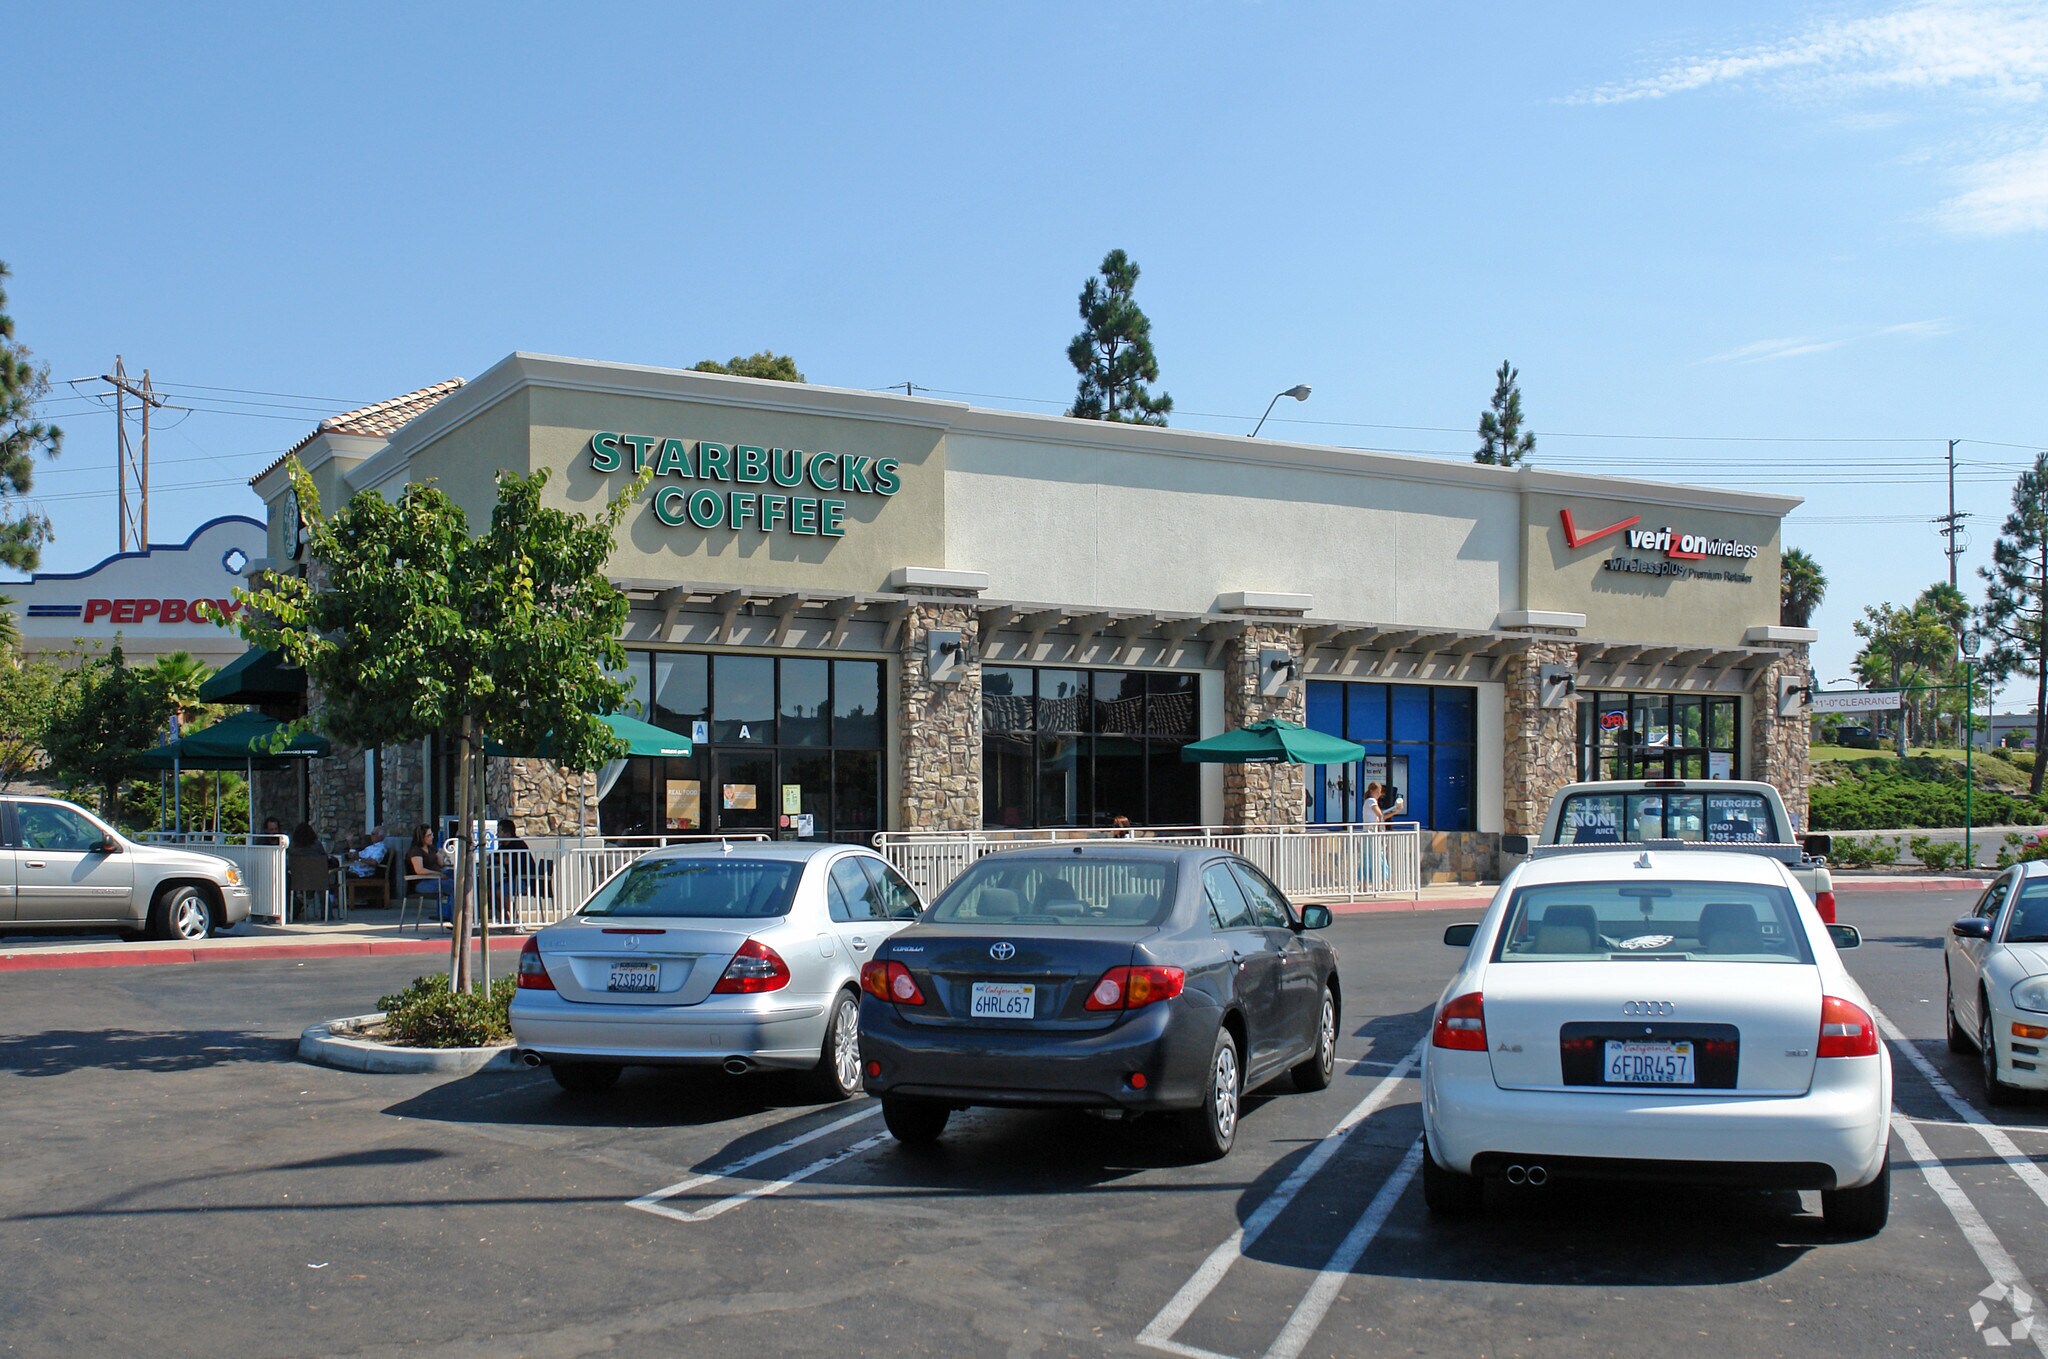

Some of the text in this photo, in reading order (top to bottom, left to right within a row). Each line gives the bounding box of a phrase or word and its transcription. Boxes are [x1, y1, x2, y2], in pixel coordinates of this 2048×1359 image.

[591, 431, 901, 496] STARBUCKS
[653, 485, 846, 537] COFFEE
[1688, 568, 1722, 581] Premium
[1723, 571, 1753, 583] Retailer
[1840, 696, 1898, 707] CLEARANCE
[1601, 714, 1624, 728] OPEN
[696, 725, 704, 736] A
[739, 725, 751, 739] A
[1710, 800, 1762, 808] ENERGIZES
[1570, 813, 1616, 827] NONI
[1709, 823, 1733, 831] (760)
[975, 996, 1030, 1013] 6HRL657
[1612, 1055, 1687, 1075] 6FDR457
